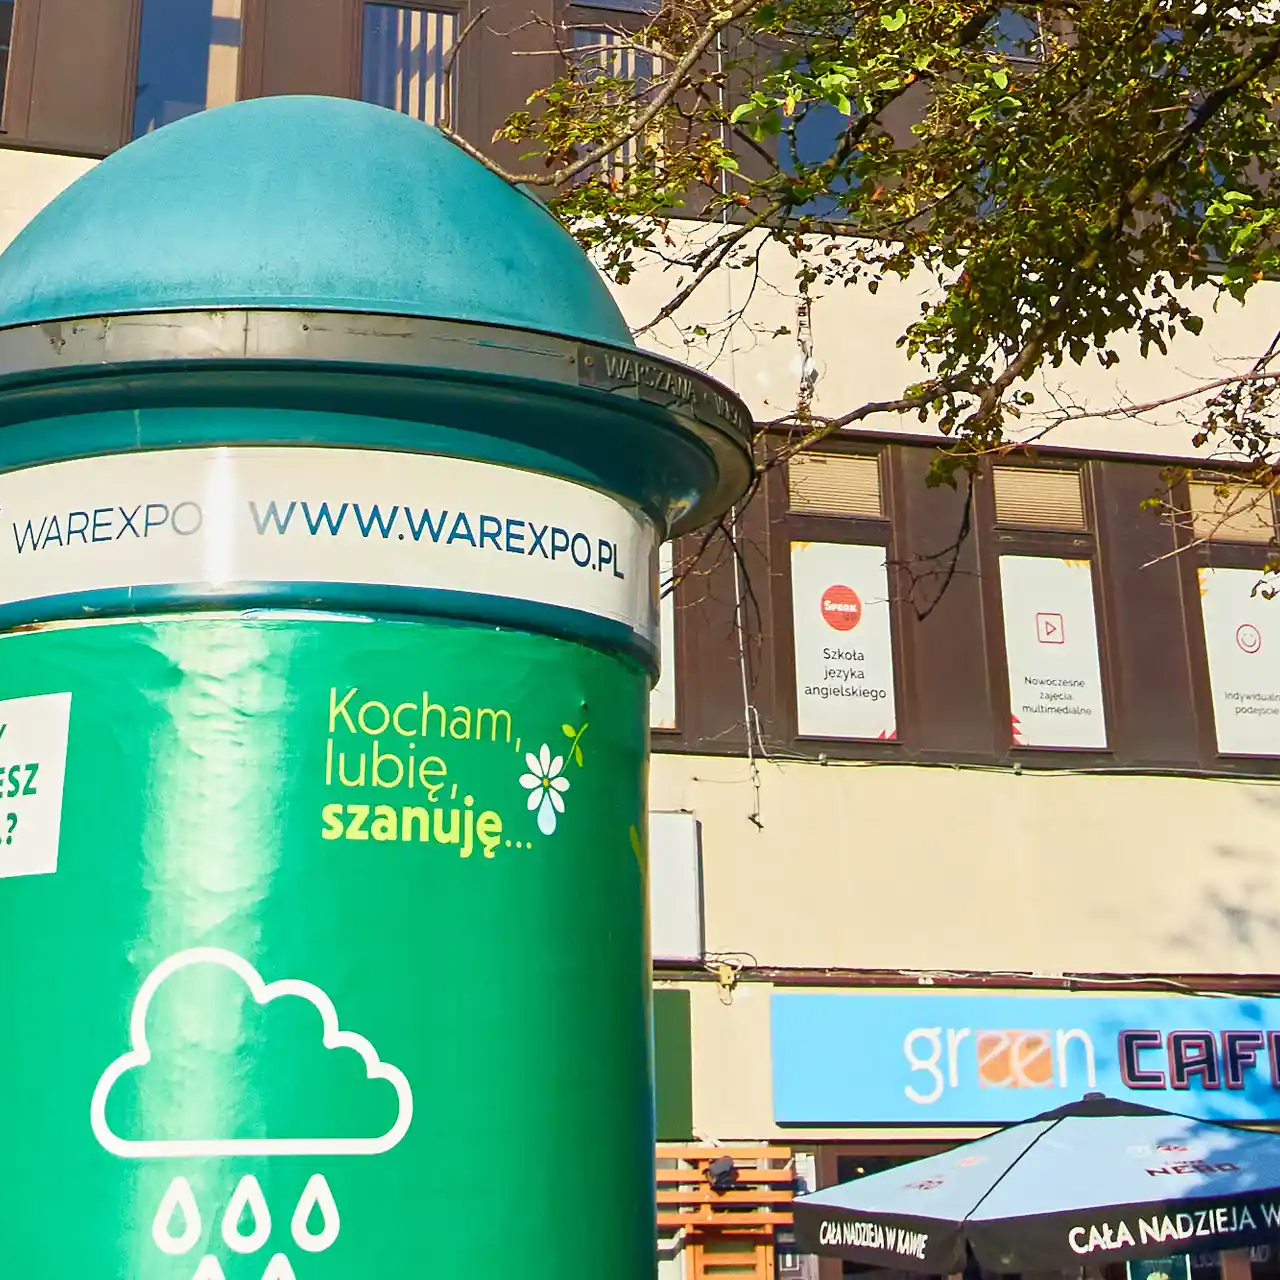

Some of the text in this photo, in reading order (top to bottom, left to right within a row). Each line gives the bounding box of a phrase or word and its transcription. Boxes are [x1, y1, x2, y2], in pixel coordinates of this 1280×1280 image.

[12, 500, 204, 554] WAREXPO
[248, 500, 625, 579] WWW.WAREXPO.PL
[822, 647, 865, 661] Szkoła
[823, 665, 865, 682] języka
[804, 684, 887, 701] angielskiego
[1024, 676, 1086, 688] Nowoczesne
[328, 687, 521, 753] Kocham,
[1022, 704, 1092, 716] multimedialne
[325, 738, 458, 802] lubię,
[321, 795, 533, 859] szanuję...
[903, 1025, 1097, 1105] green
[843, 1222, 884, 1249] NADZIEJA
[885, 1227, 896, 1251] W
[897, 1228, 928, 1259] KAWIE
[1068, 1220, 1135, 1254] CAŁA
[1137, 1206, 1256, 1245] NADZIEJA
